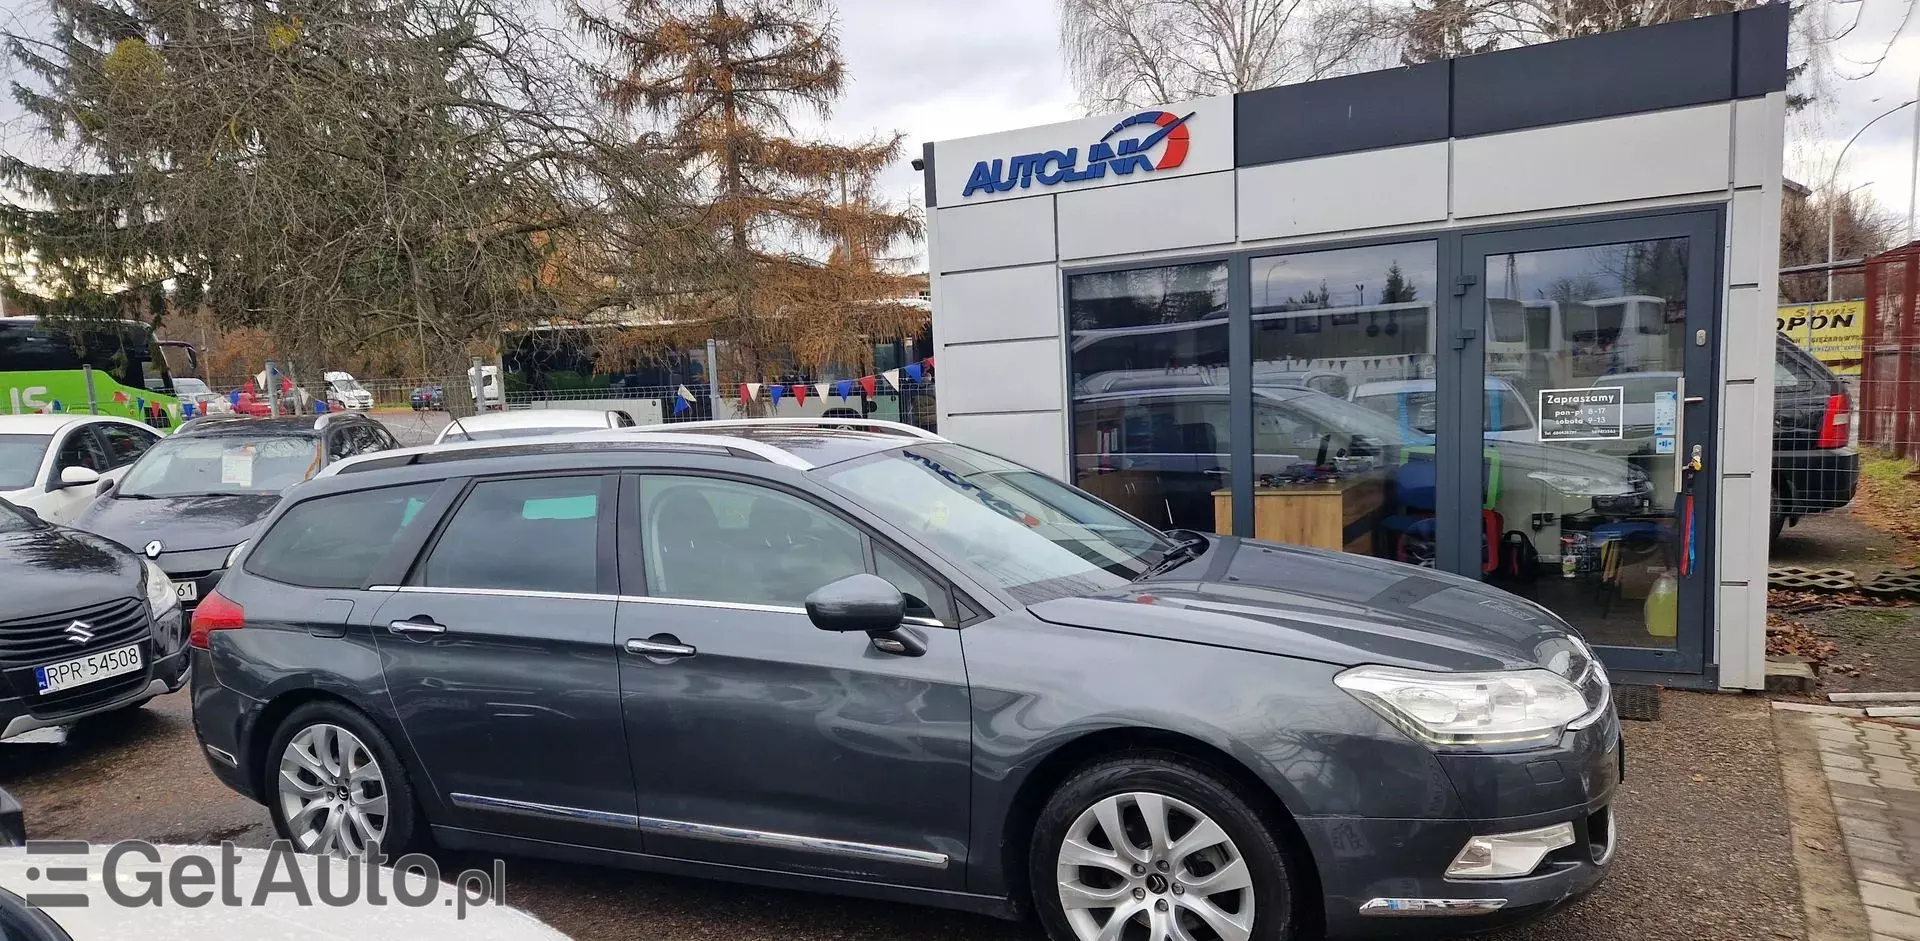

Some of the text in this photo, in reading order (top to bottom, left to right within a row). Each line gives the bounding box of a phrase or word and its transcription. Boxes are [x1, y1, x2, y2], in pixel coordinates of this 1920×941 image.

[962, 134, 1160, 197] AUTOLINK
[1547, 394, 1614, 405] Zapraszamy
[1554, 409, 1584, 417] pon-pt
[1554, 416, 1606, 425] sobota 9-13
[47, 648, 138, 686] RPR 54508
